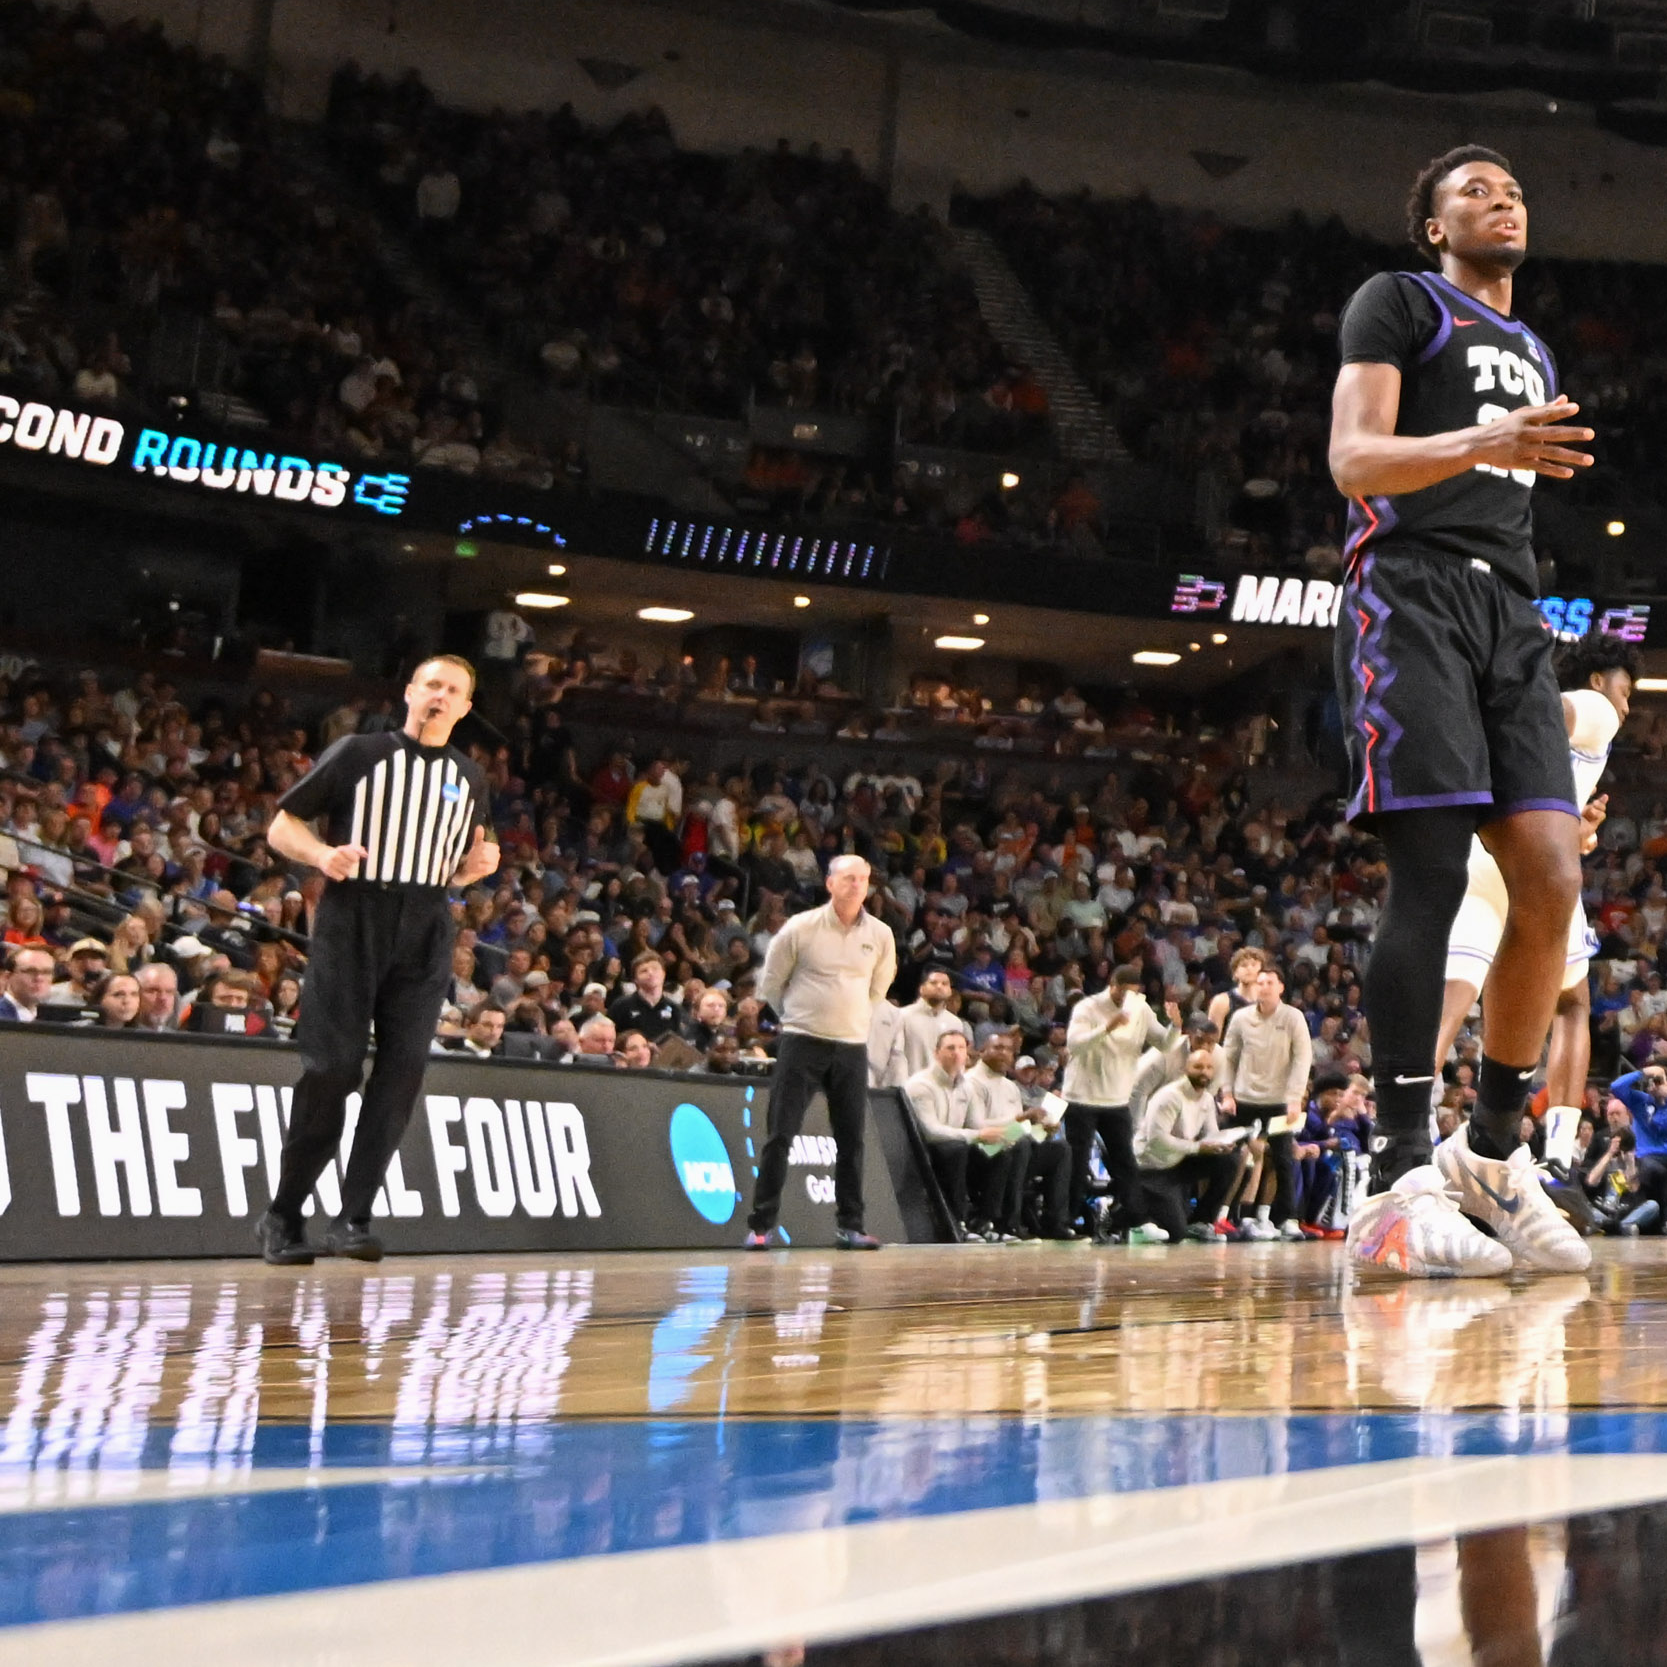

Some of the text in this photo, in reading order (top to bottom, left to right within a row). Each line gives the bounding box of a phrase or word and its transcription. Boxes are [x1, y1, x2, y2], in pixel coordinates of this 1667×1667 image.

[1467, 345, 1546, 408] TCU
[132, 428, 351, 507] ROUNDS
[26, 1072, 203, 1217] THE
[424, 1094, 602, 1217] FOUR
